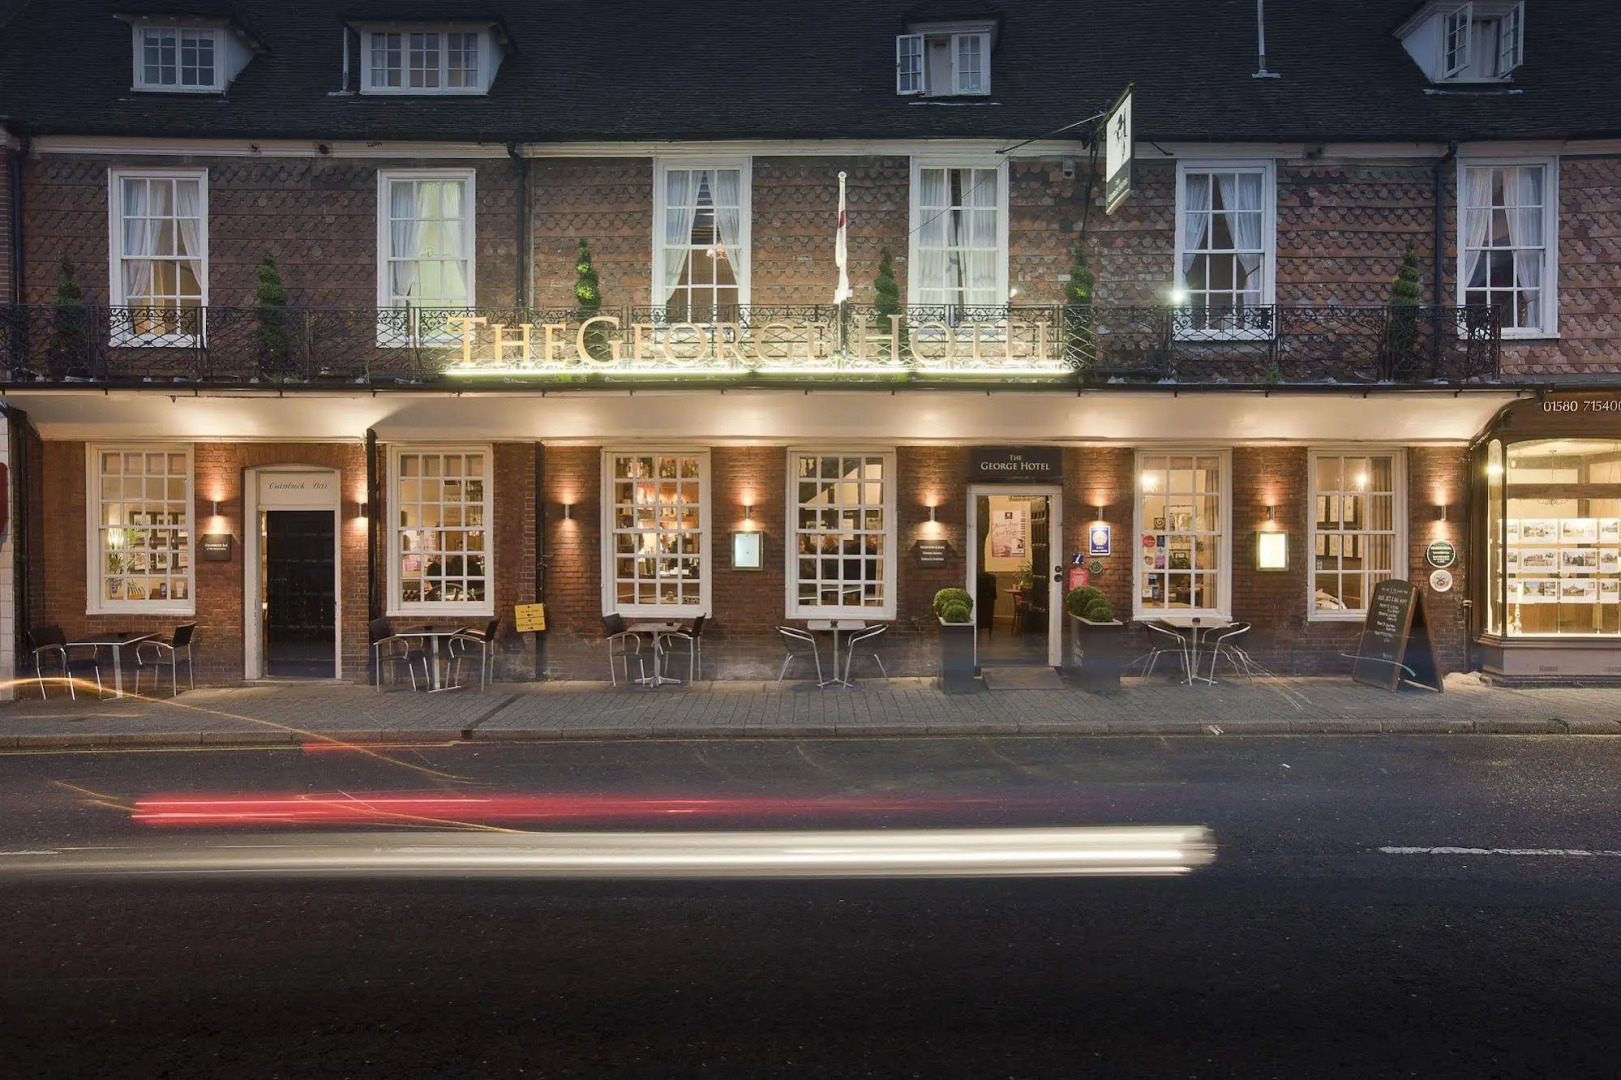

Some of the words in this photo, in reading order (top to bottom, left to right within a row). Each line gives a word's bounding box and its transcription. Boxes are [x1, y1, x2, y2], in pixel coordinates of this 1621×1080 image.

[576, 315, 831, 366] GEORGE
[852, 314, 1066, 366] HOTEL
[1543, 400, 1578, 412] 01580
[980, 461, 1018, 471] GEORGE
[1020, 461, 1051, 471] HOTEL
